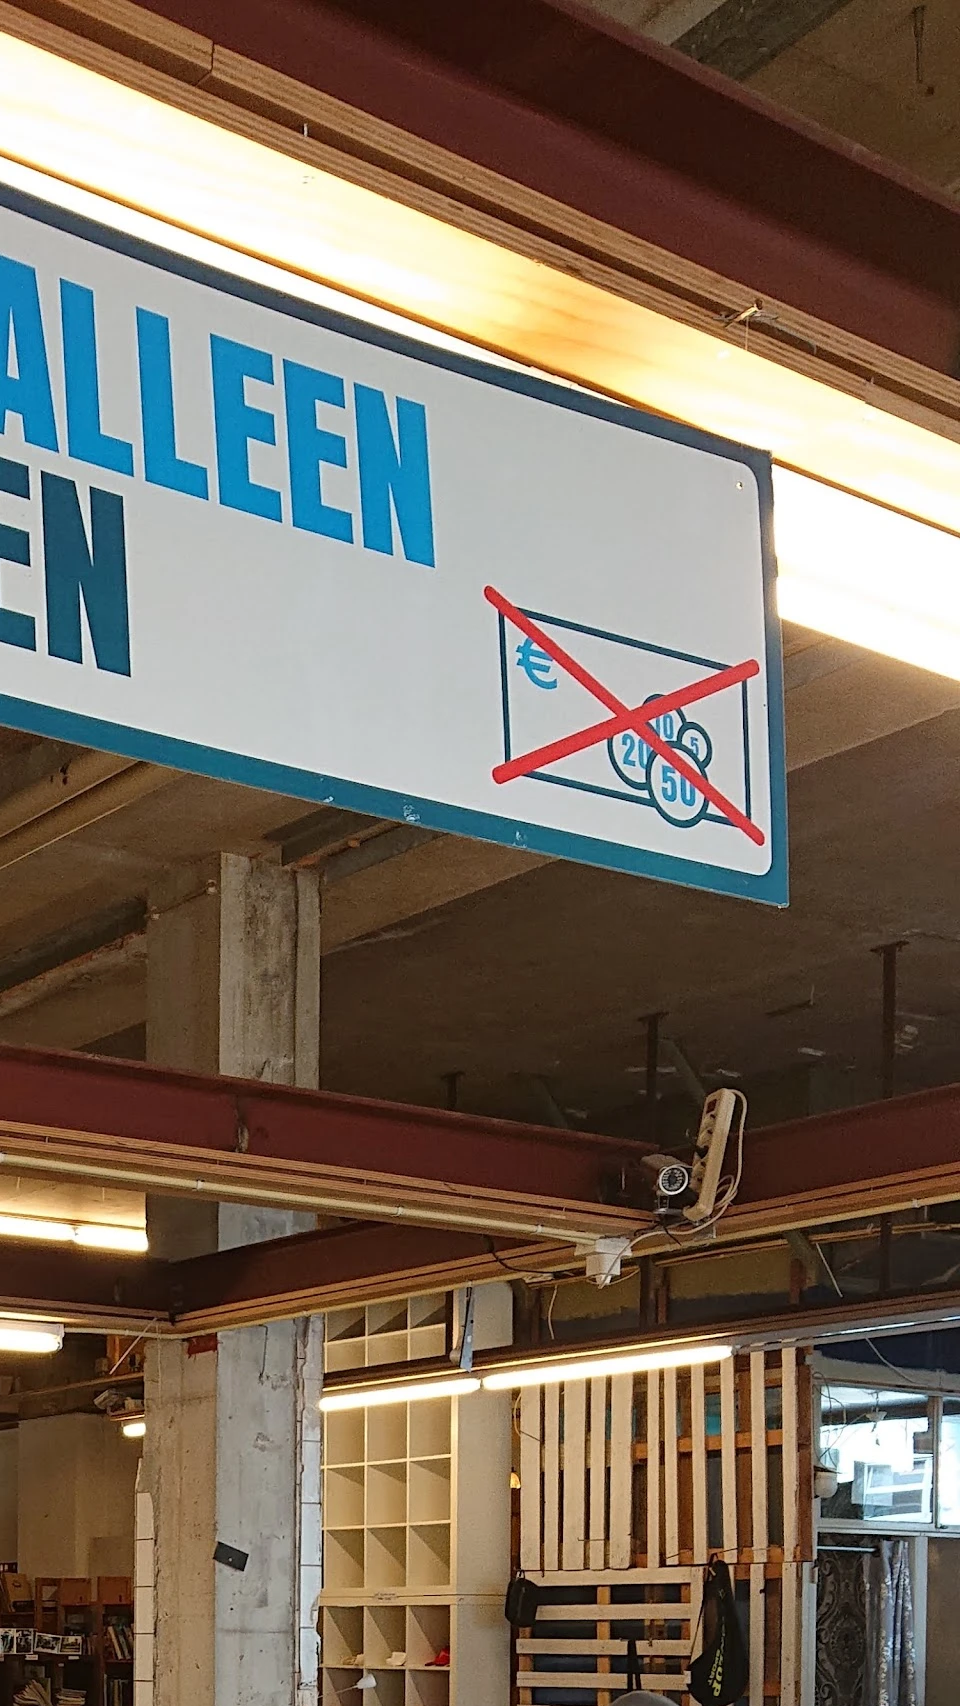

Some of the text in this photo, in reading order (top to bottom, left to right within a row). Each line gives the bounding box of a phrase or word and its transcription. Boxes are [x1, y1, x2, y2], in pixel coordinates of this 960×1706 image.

[621, 733, 652, 770] 20
[689, 736, 700, 757] 5
[660, 763, 697, 808] 50
